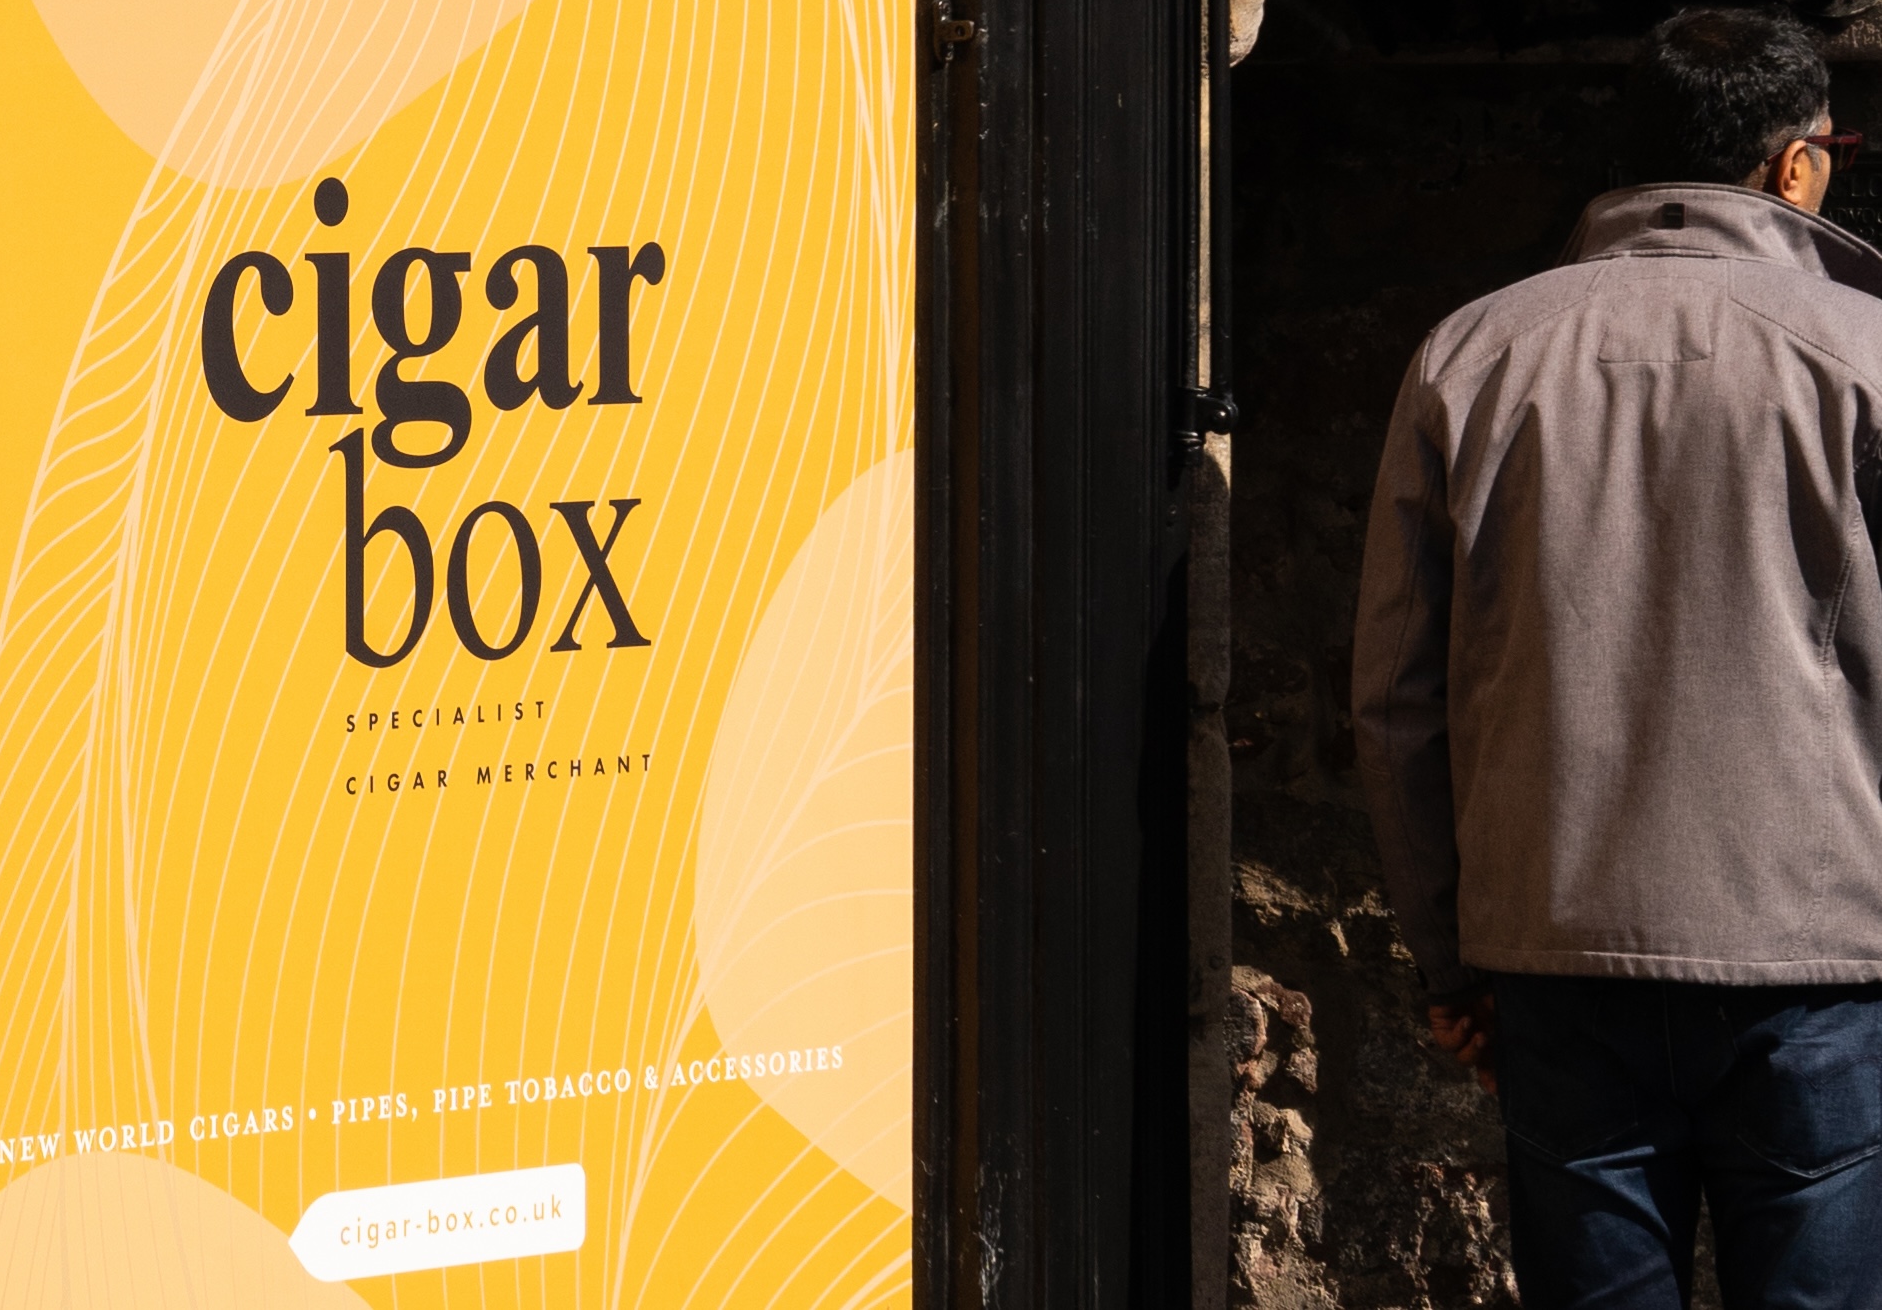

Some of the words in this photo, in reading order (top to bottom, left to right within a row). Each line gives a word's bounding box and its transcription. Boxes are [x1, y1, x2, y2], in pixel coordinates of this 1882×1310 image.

[202, 177, 666, 469] cigar
[328, 427, 652, 669] box
[346, 700, 545, 733] SPECIALIST
[346, 768, 449, 796] CIGAR
[476, 754, 651, 786] MERCHANT
[73, 1120, 175, 1156] WORLD
[189, 1105, 294, 1142] CIGARS
[331, 1092, 418, 1125] PIPES,
[433, 1083, 493, 1113] PIPE
[505, 1067, 632, 1105] TOBACCO
[644, 1065, 660, 1090] &
[670, 1044, 845, 1087] ACCESSORIES
[339, 1193, 563, 1250] cigar-box.co.uk
